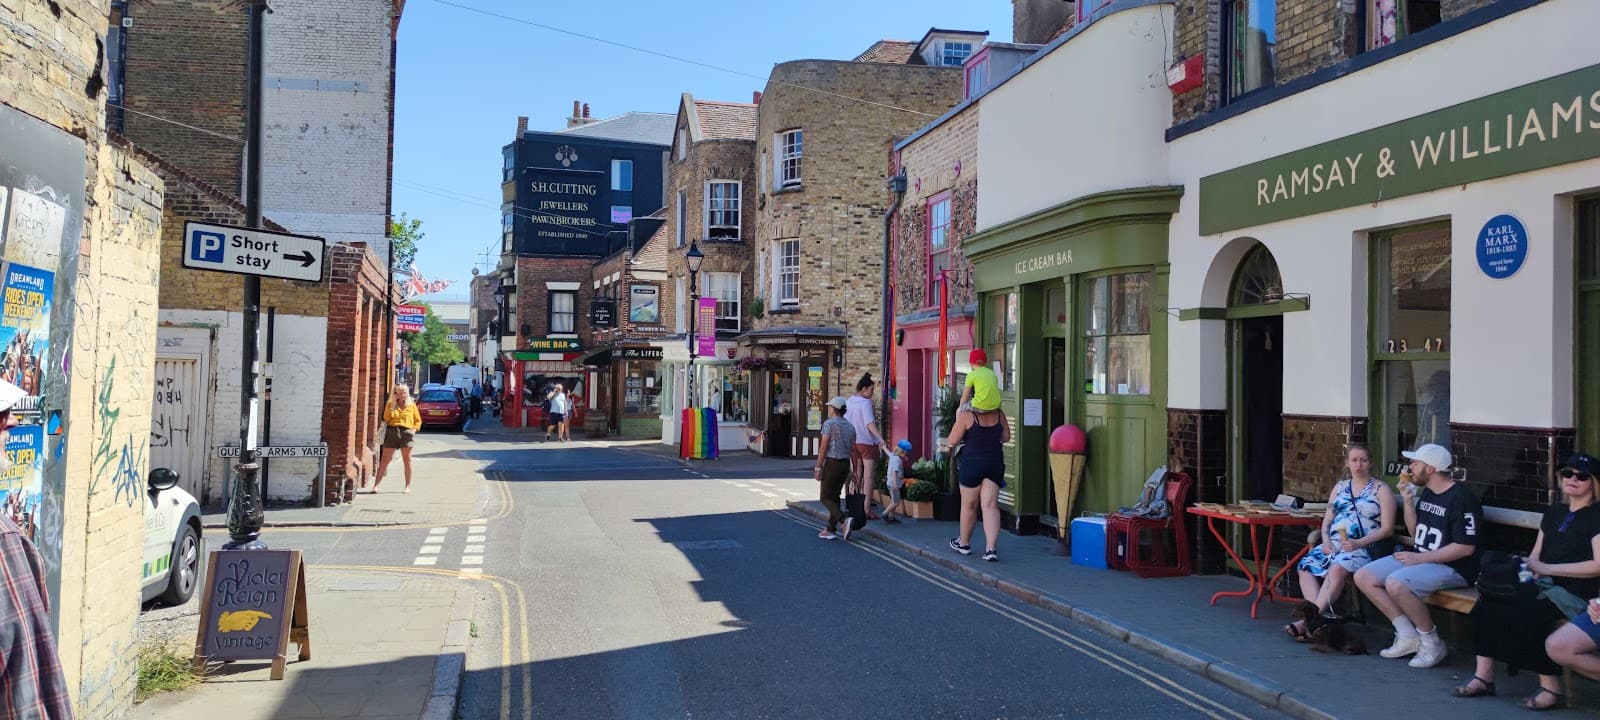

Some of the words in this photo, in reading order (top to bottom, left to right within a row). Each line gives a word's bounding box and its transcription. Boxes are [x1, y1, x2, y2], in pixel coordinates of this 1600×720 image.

[1257, 153, 1363, 206] RAMSAY
[1376, 147, 1396, 178] &
[1410, 90, 1600, 169] WILLIAMS
[531, 181, 597, 196] S.H.CUTTING
[539, 200, 589, 212] JEWELLERS
[531, 215, 597, 227] PAWNBROKERS
[537, 230, 574, 239] ESTABLISHED
[1487, 224, 1514, 237] KARL
[199, 234, 220, 259] P
[231, 235, 279, 253] Short
[1485, 233, 1518, 248] MARX
[236, 253, 271, 270] stay
[1015, 261, 1026, 274] ICE
[1028, 254, 1054, 271] CREAM
[1056, 249, 1073, 265] BAR
[10, 272, 44, 290] DREAMLAND
[5, 287, 26, 305] RIDES
[27, 291, 44, 308] OPEN
[532, 340, 551, 349] WINE
[552, 340, 568, 349] BAR
[16, 448, 36, 464] OPEN
[220, 446, 262, 457] QUES
[267, 446, 296, 456] ARMS
[301, 446, 326, 456] YARD
[228, 559, 284, 590] Violet
[217, 577, 277, 607] Reign
[215, 634, 273, 650] Vintage
